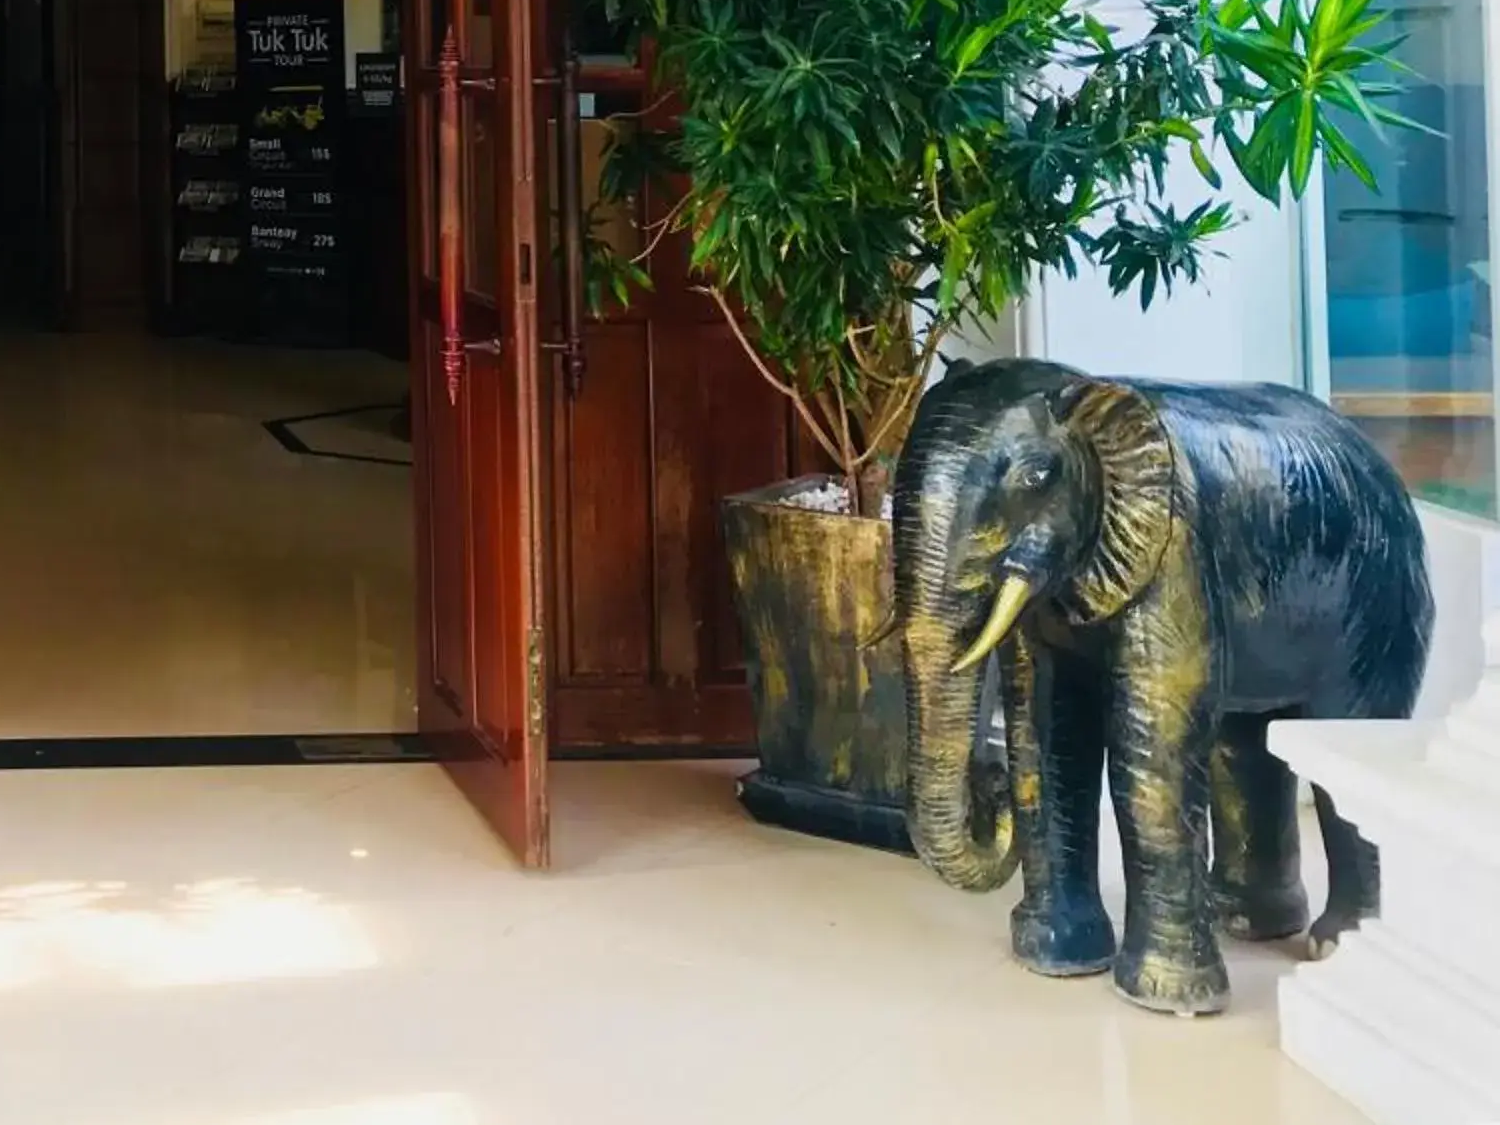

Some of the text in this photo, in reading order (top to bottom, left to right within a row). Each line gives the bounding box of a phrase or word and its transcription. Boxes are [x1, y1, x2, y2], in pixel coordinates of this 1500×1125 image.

[267, 14, 309, 26] PRIVATE
[246, 26, 329, 53] Tuk Tuk
[273, 54, 305, 66] TOUR
[249, 137, 282, 150] Small
[250, 186, 285, 199] Grand
[251, 224, 298, 241] Banteay
